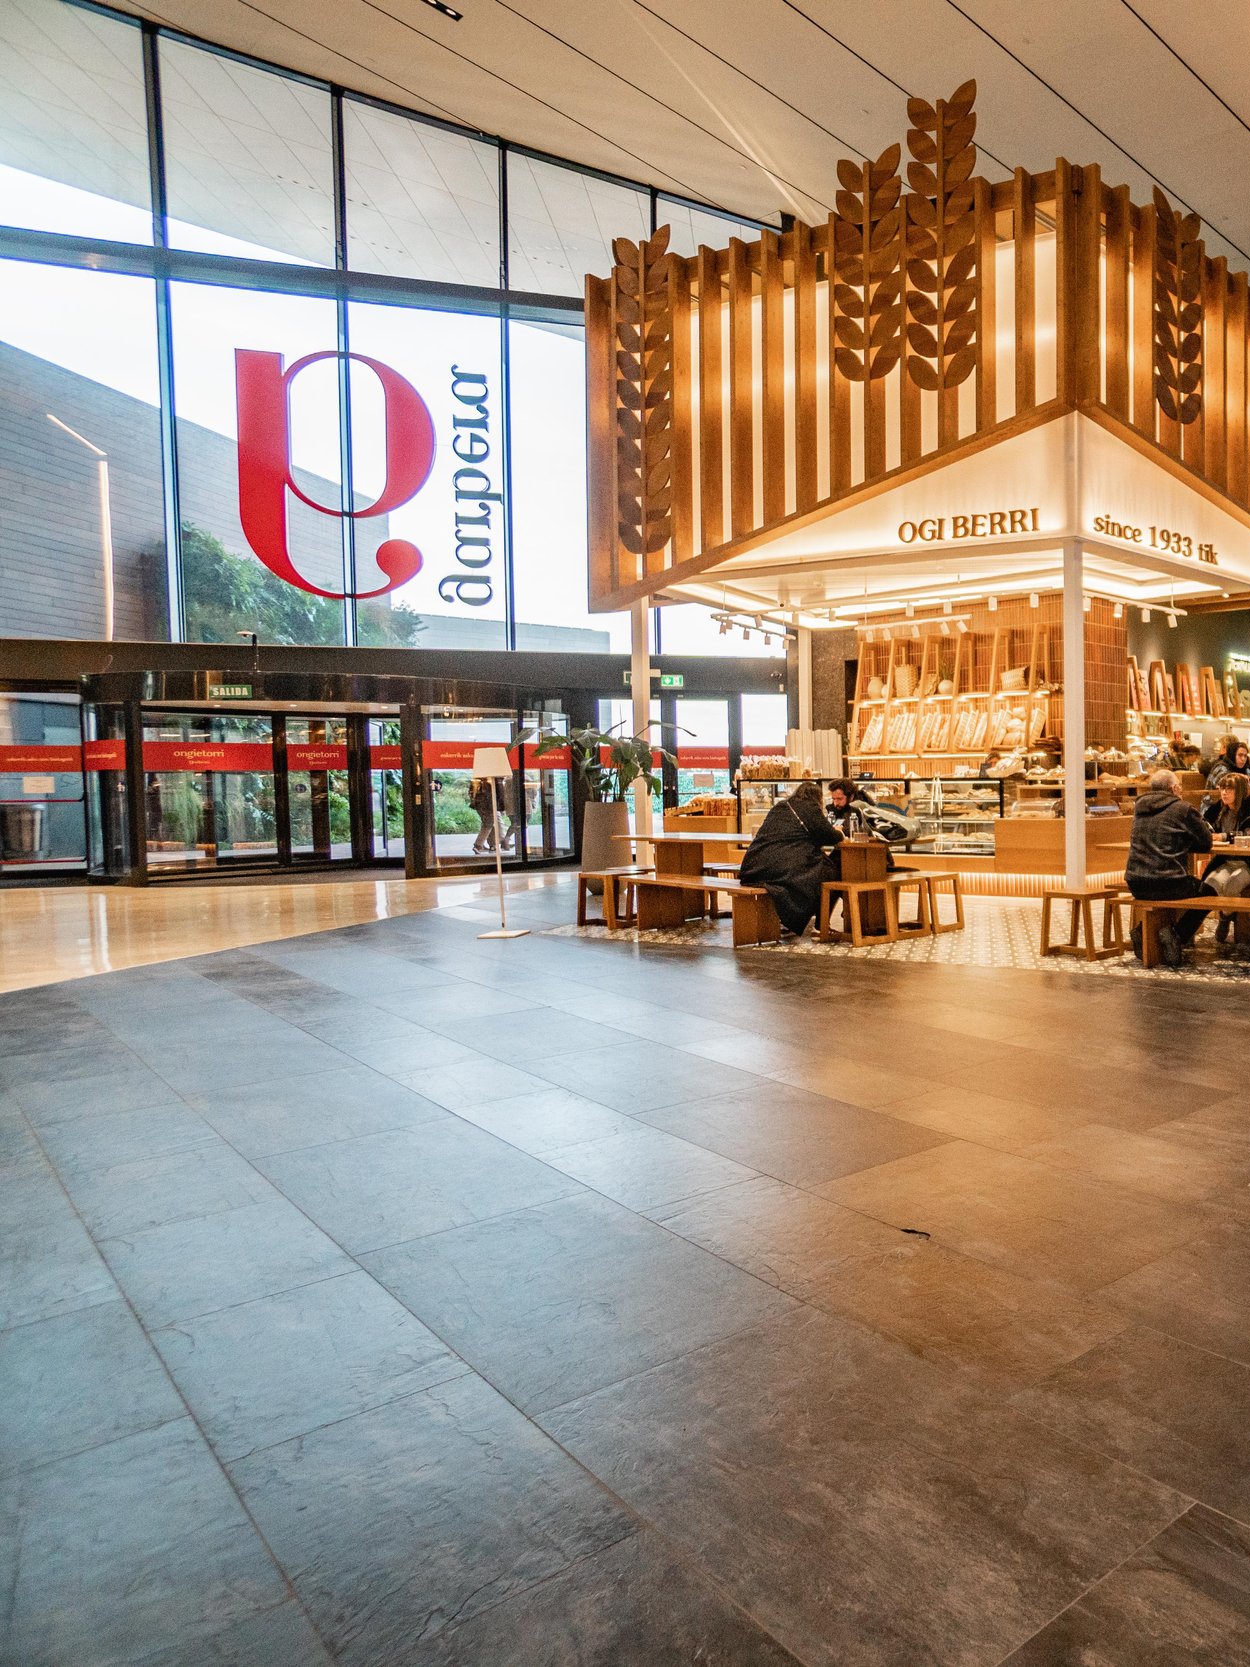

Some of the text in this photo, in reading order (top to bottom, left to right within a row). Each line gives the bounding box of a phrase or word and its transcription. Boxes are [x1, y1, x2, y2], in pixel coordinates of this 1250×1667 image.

[898, 508, 1040, 544] OGI BERRI
[1093, 514, 1219, 566] since 1933 tik
[212, 686, 249, 697] SALIDA
[173, 749, 225, 760] ongietorri
[296, 750, 340, 761] ongietorri
